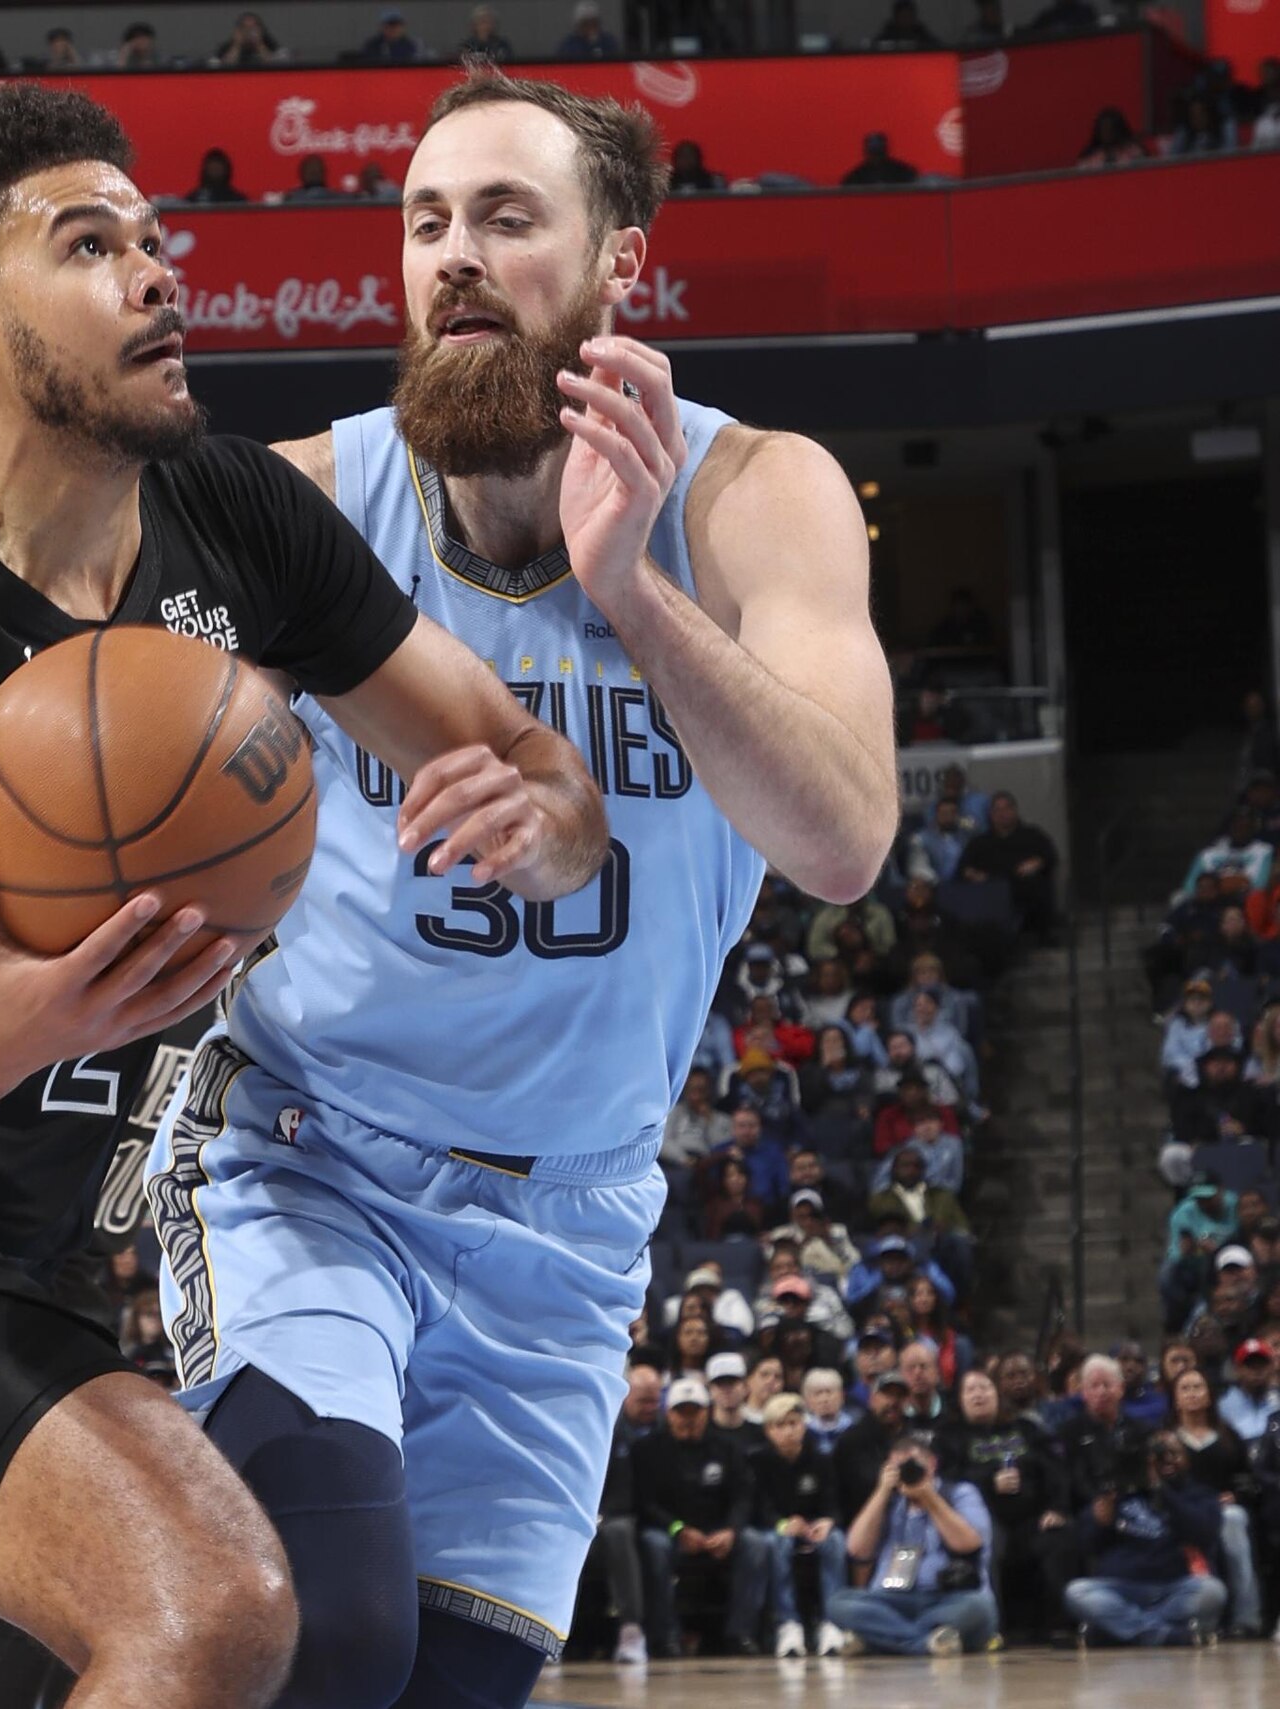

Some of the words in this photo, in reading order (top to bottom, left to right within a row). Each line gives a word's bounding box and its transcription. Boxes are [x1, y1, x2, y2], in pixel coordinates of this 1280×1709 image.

[170, 264, 397, 338] hick-fil-A
[160, 589, 199, 621] GET
[166, 605, 231, 639] YOUR
[412, 837, 632, 960] 30
